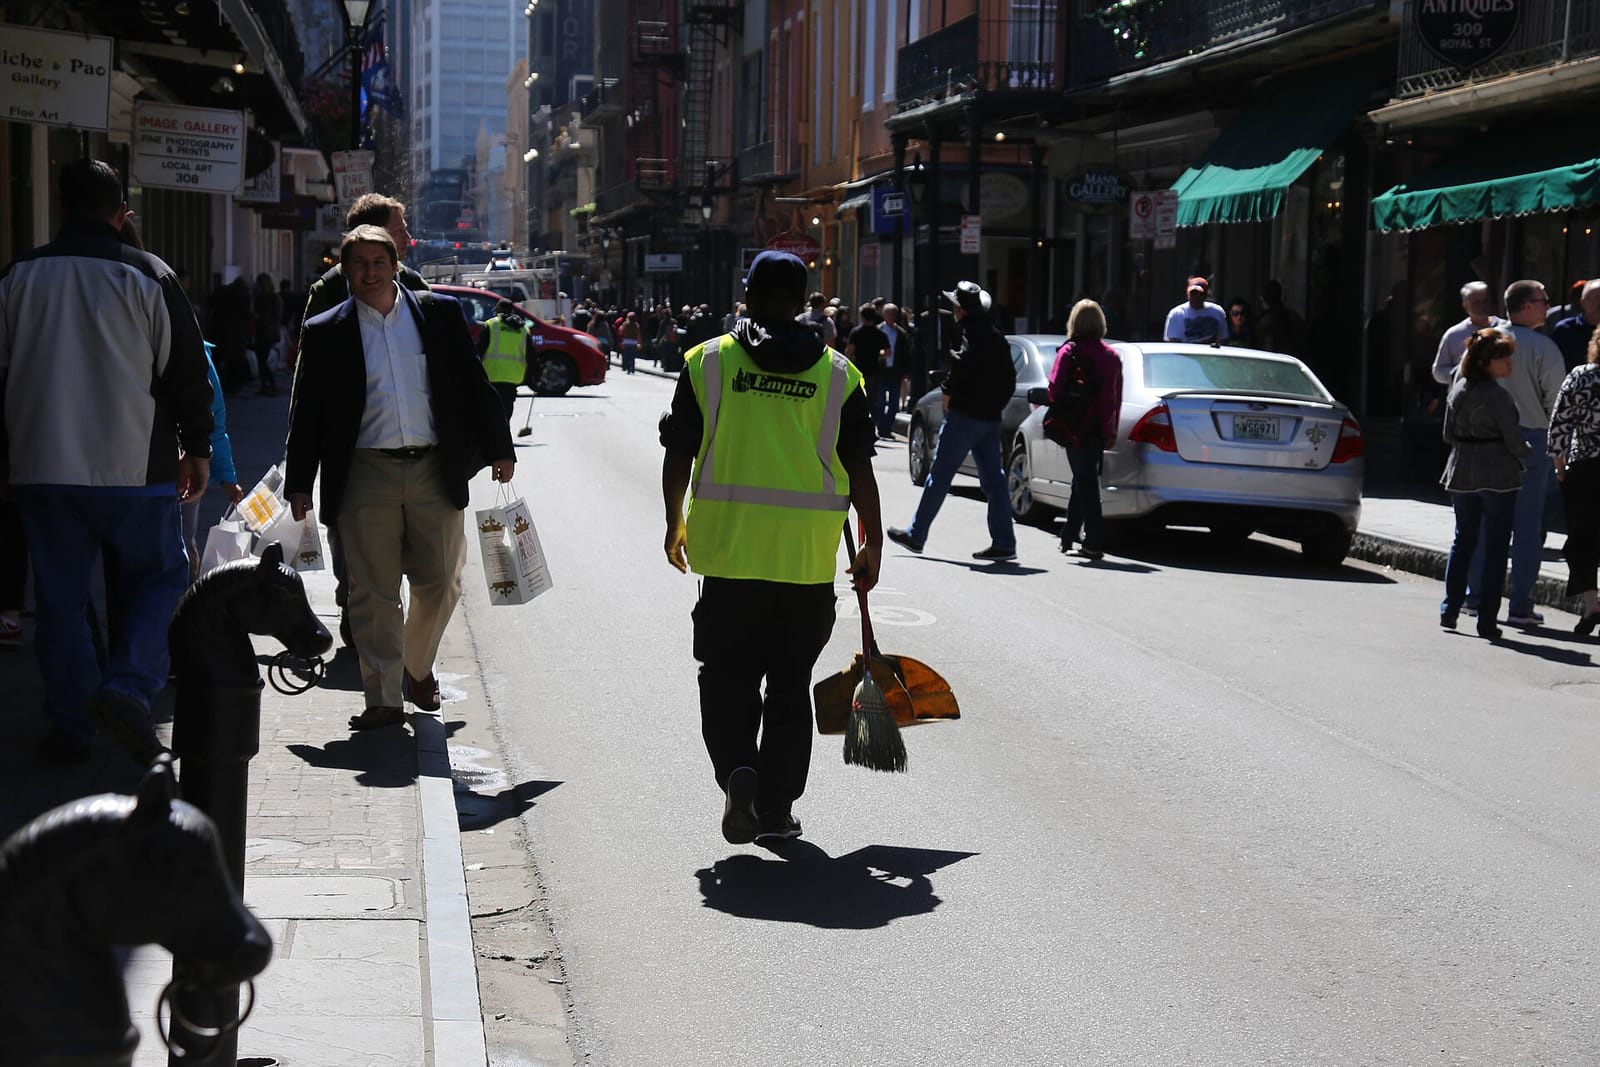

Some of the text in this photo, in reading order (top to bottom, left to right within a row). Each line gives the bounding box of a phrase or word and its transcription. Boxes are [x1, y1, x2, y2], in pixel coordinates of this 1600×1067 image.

[1422, 0, 1515, 19] ANTIQUES
[1453, 23, 1483, 36] 309
[1440, 38, 1474, 49] ROYAL
[70, 58, 106, 77] Pao
[11, 72, 61, 89] Gallery
[9, 105, 59, 121] Fine Art
[140, 116, 237, 135] IMAGE GALLERY
[141, 134, 234, 151] FINE PHOTOGRAPHY
[177, 147, 210, 157] PRINTS
[162, 161, 213, 173] LOCAL ART
[175, 173, 199, 184] 308
[342, 174, 363, 185] FIRE
[1085, 173, 1119, 185] MANN
[1069, 183, 1128, 198] GALLERY
[753, 375, 816, 396] Empire
